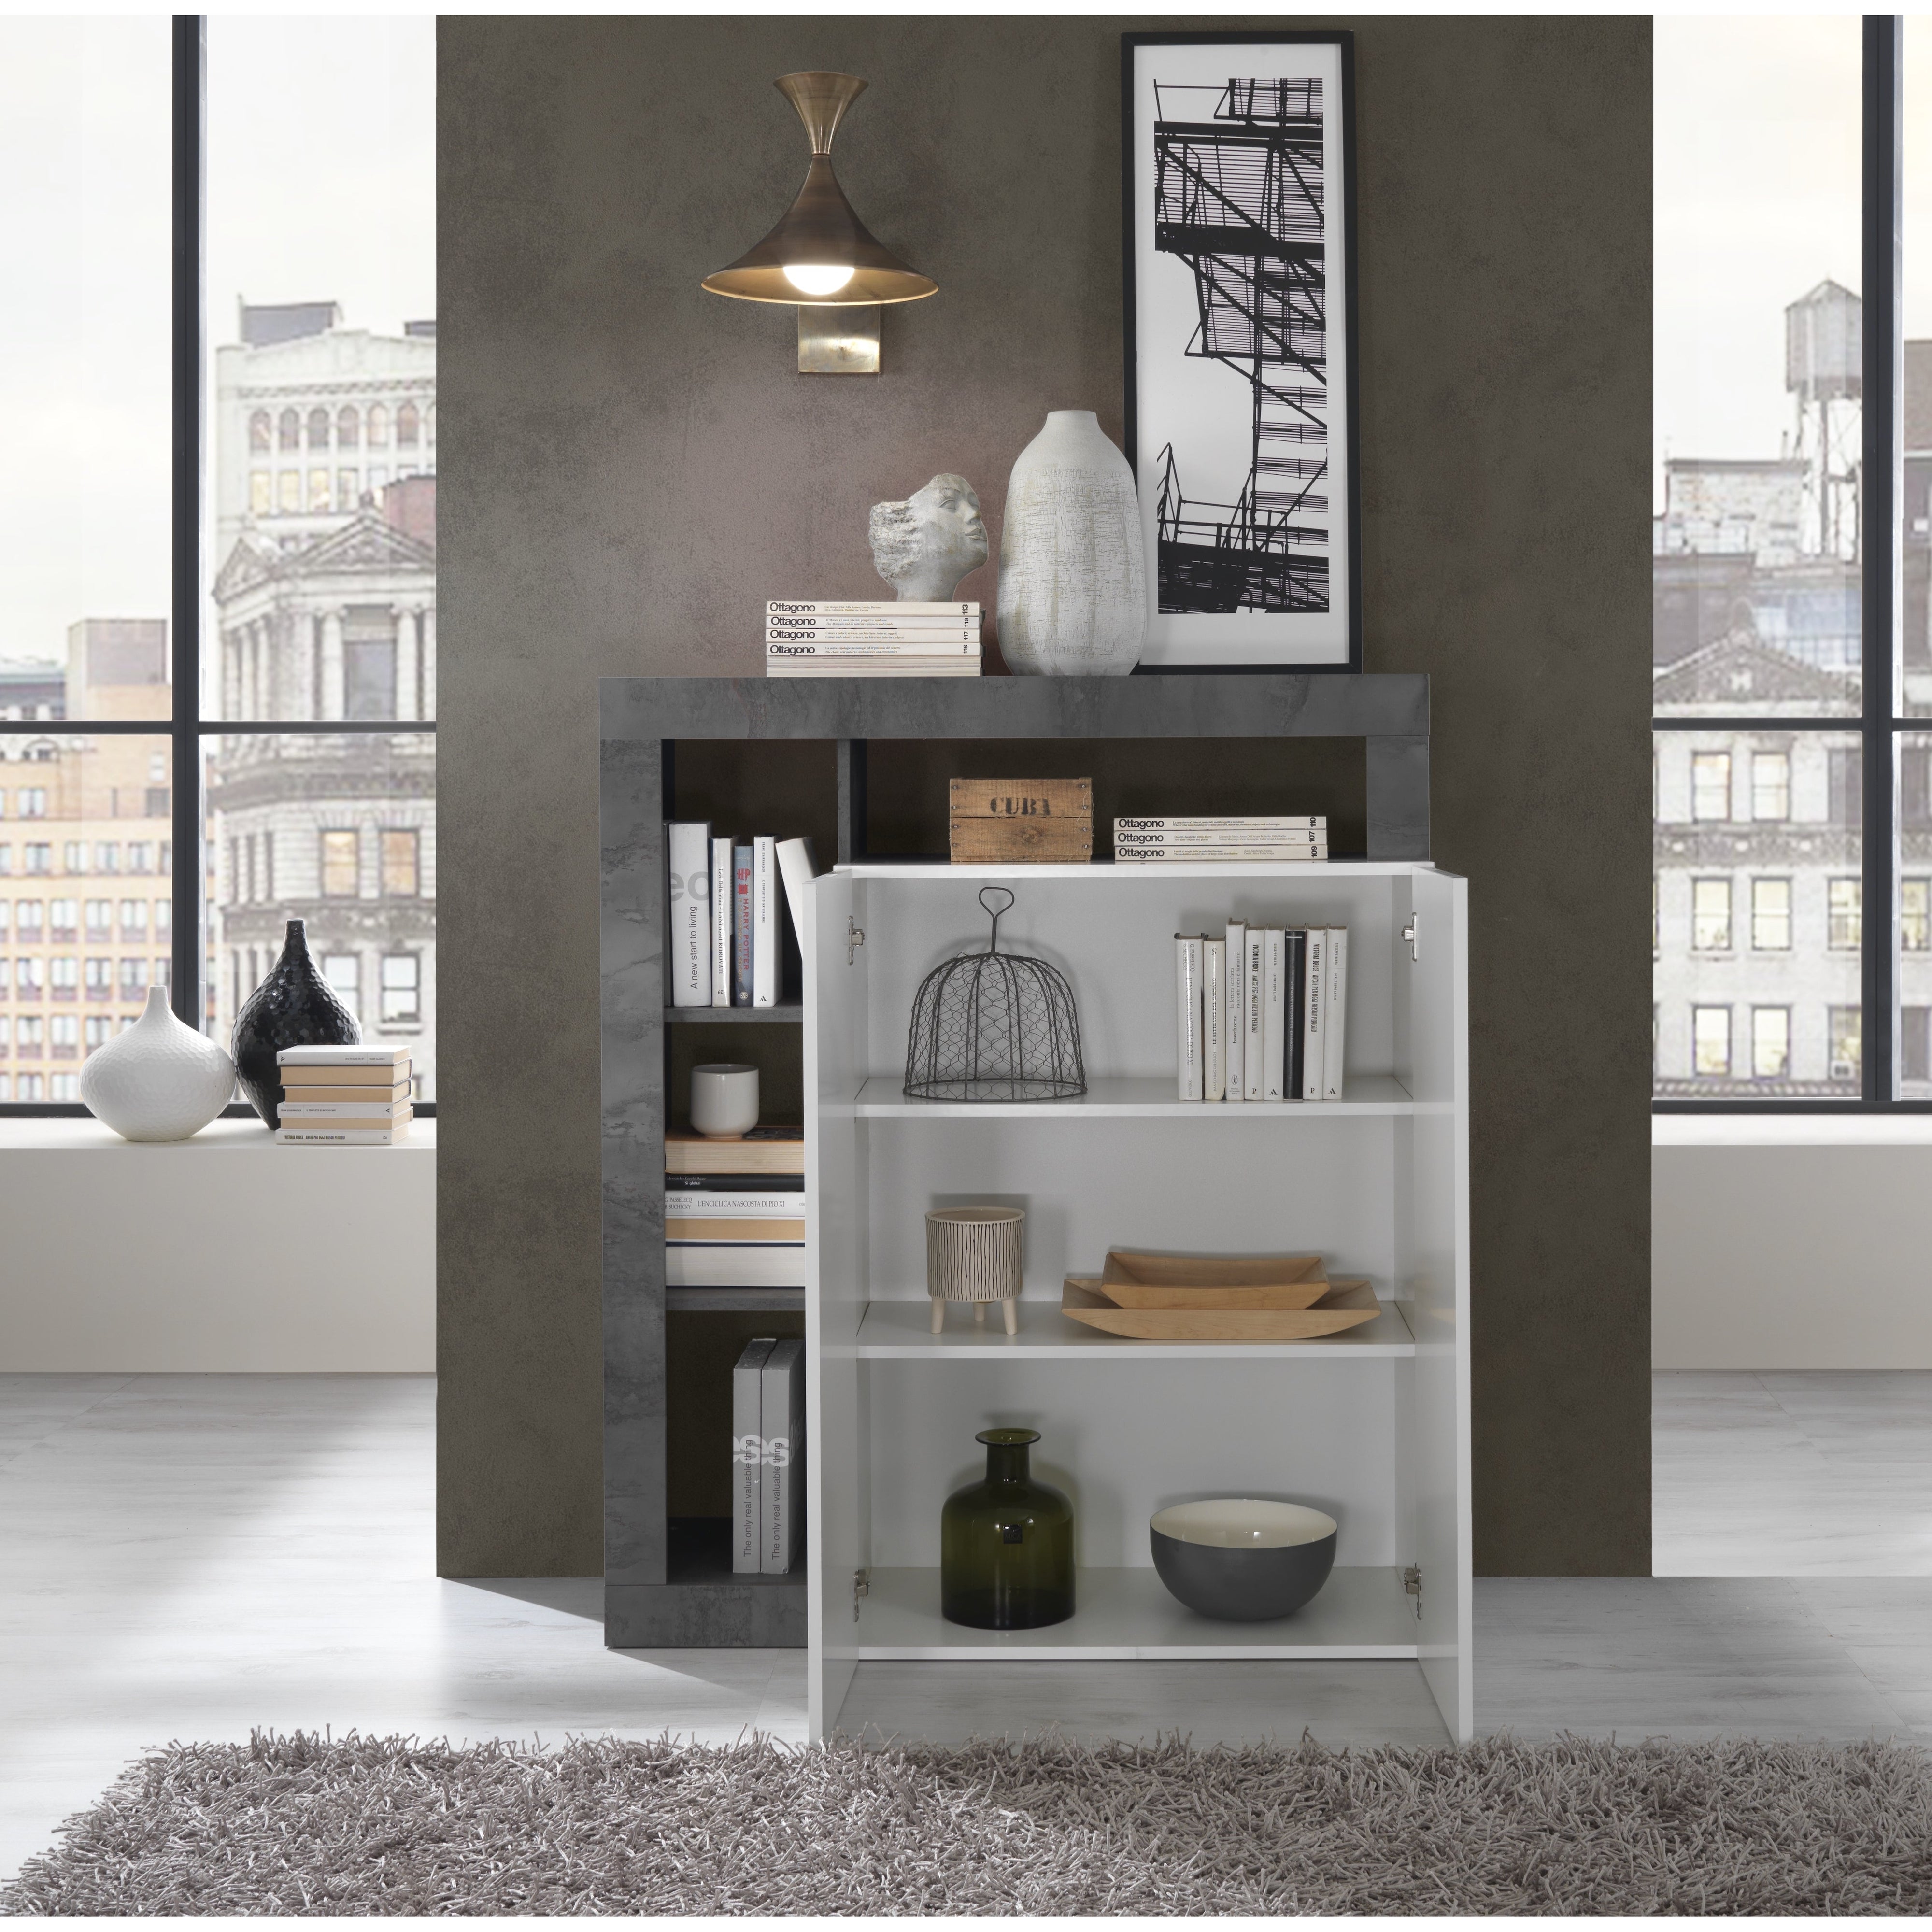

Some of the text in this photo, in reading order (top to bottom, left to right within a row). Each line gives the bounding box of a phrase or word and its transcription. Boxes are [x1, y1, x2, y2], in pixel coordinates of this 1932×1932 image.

[770, 602, 815, 613] Ottagono
[771, 617, 816, 627] Ottagono
[770, 630, 815, 640] Ottagono
[770, 645, 815, 656] Ottagono
[1119, 819, 1165, 830] Ottagono
[1118, 833, 1164, 844] Ottagono
[1119, 848, 1165, 858] Ottagono
[689, 906, 698, 928] living
[744, 1439, 753, 1461] thing
[773, 1442, 782, 1463] thing
[744, 1520, 753, 1538] only
[773, 1522, 782, 1540] only
[743, 1540, 752, 1557] The
[772, 1543, 780, 1560] The
